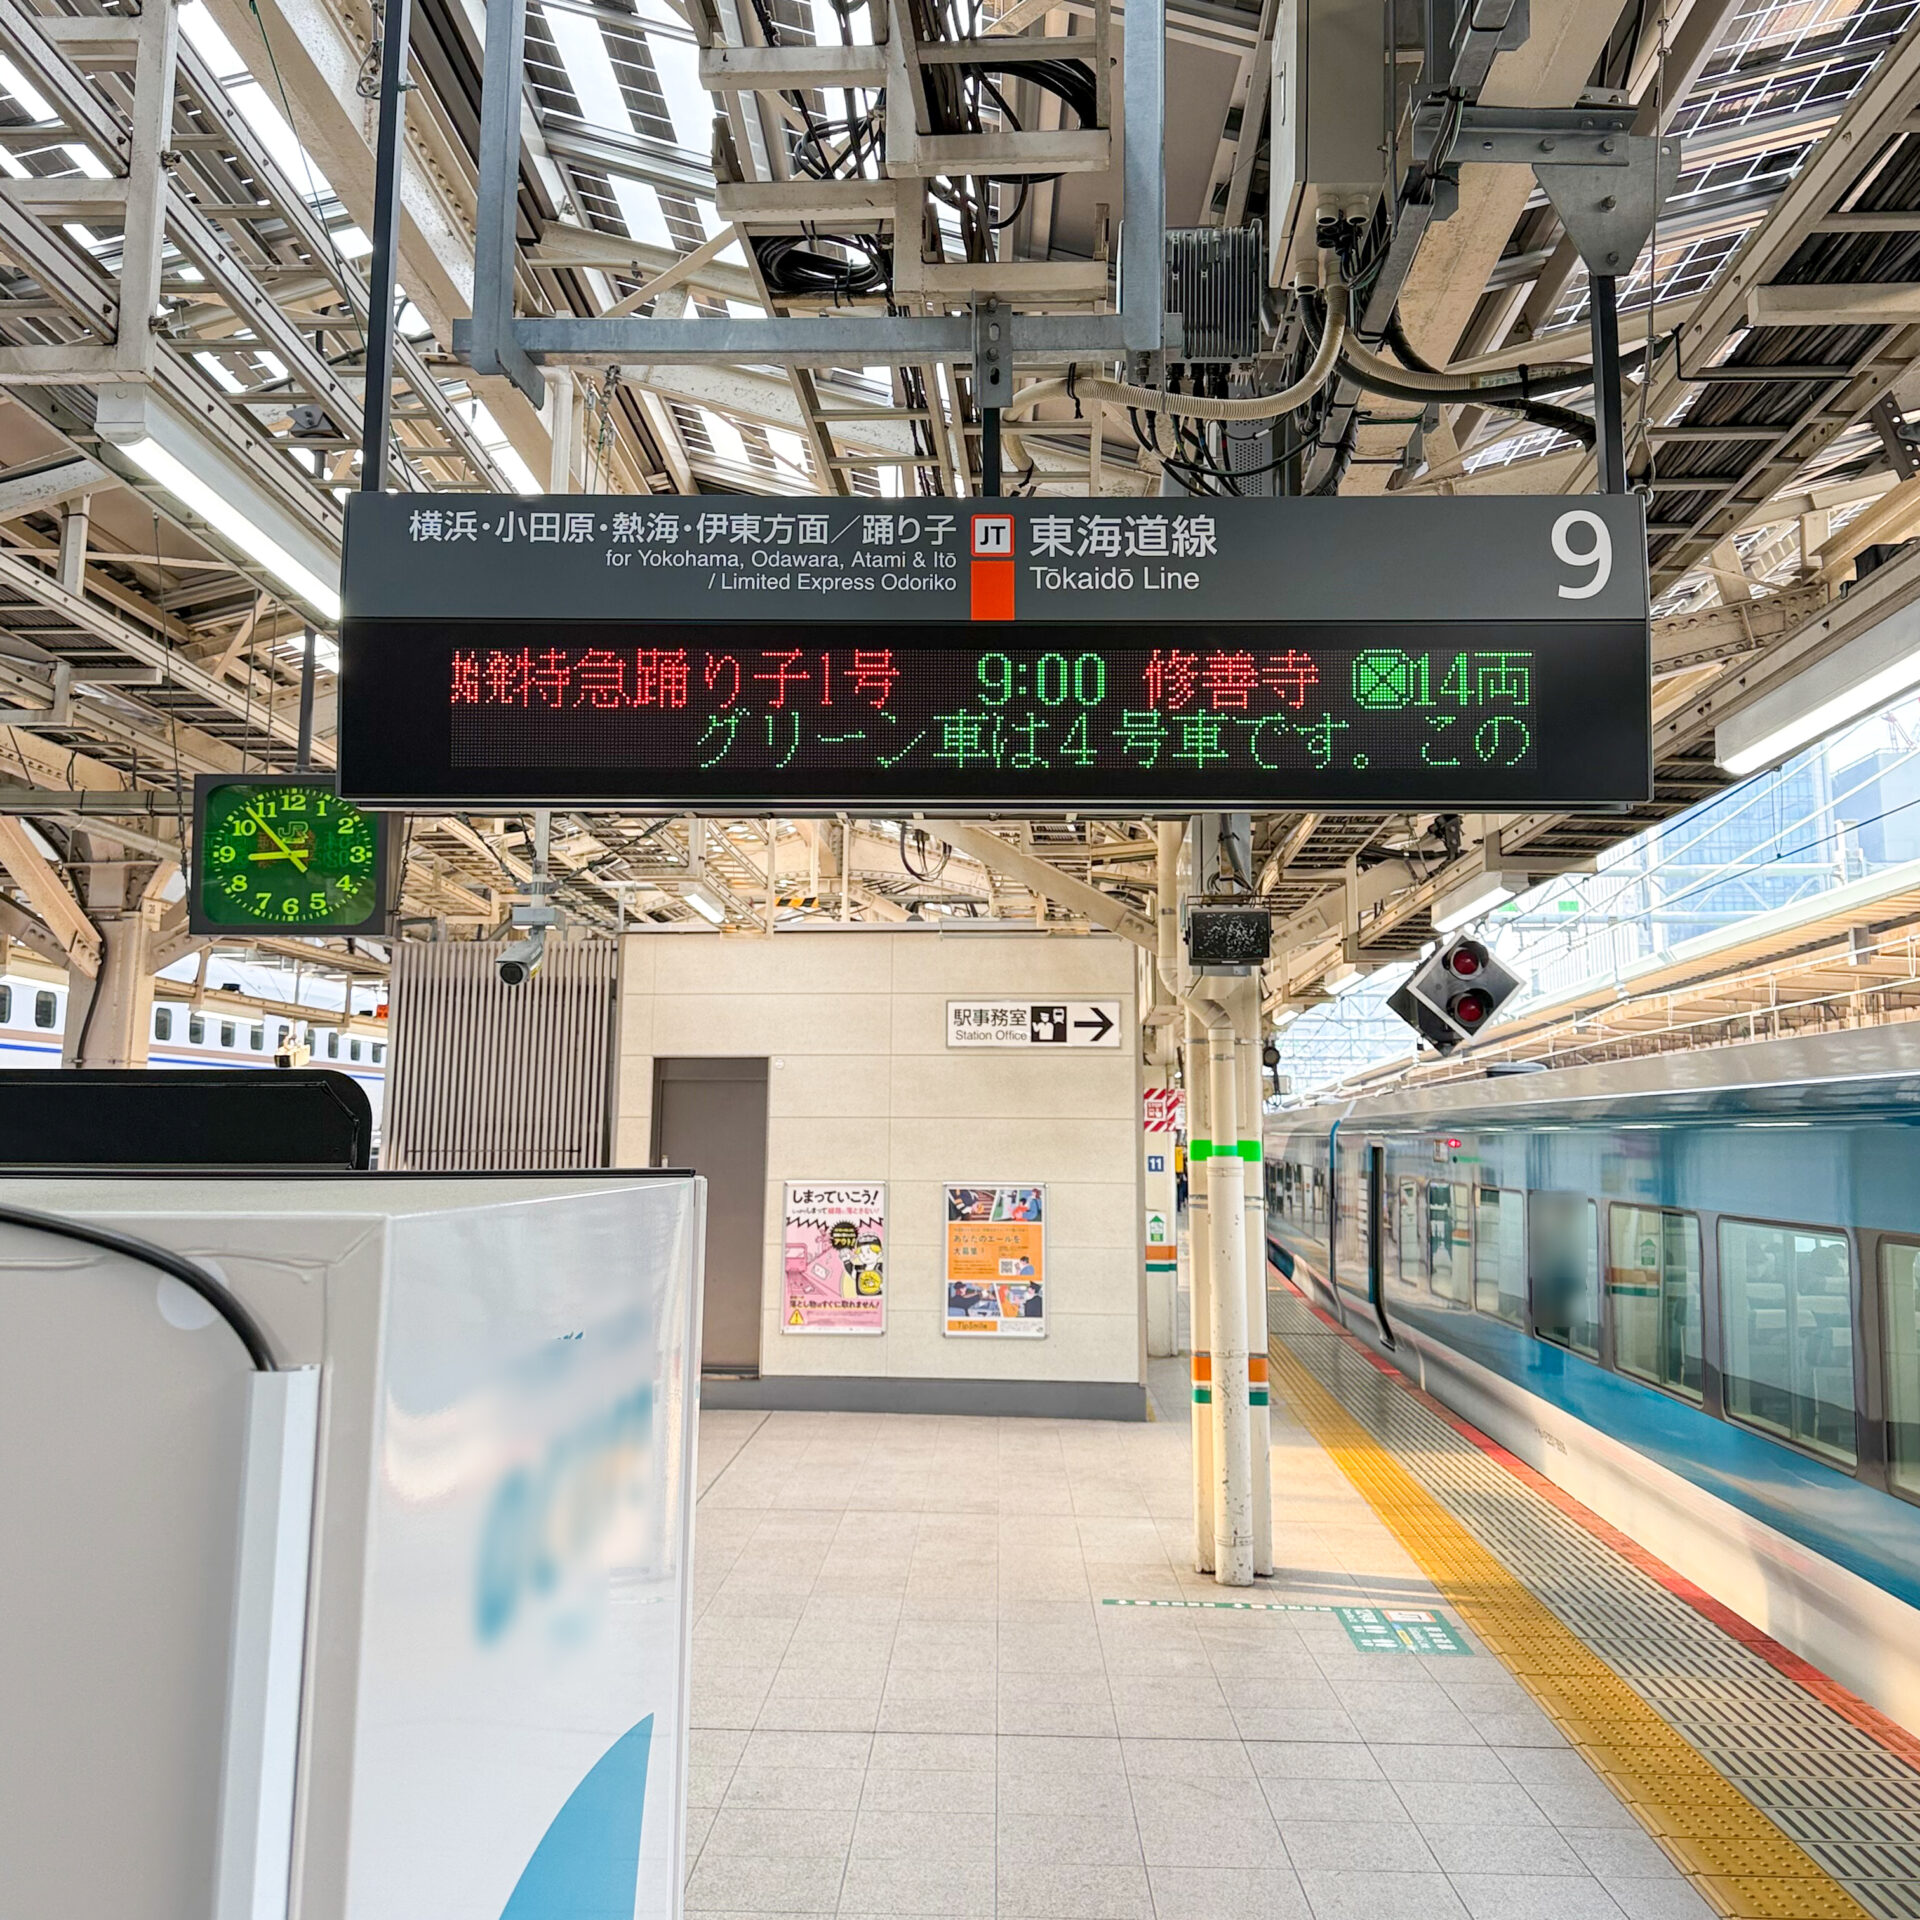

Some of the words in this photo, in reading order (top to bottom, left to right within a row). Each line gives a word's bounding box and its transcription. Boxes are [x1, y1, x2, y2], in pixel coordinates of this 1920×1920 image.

[979, 525, 1006, 547] JT
[1029, 514, 1218, 558] 東海道線
[605, 550, 632, 568] for
[638, 550, 745, 571] Yokohama,
[751, 550, 845, 571] Odawara,
[851, 550, 906, 568] Atami
[912, 550, 927, 568] &
[934, 550, 957, 568] Itō
[1551, 510, 1613, 599] 9
[721, 573, 790, 592] Limited
[797, 573, 875, 594] Express
[881, 573, 957, 592] Odoriko
[1029, 565, 1134, 590] Tōkaidō
[1144, 565, 1200, 590] Line
[977, 652, 1106, 706] 9:00
[1142, 648, 1320, 709] 修善寺
[1413, 651, 1533, 706] 14両
[256, 801, 278, 818] 11
[281, 794, 306, 811] 12
[316, 800, 328, 816] 1
[232, 819, 257, 836] 10
[337, 817, 354, 834] 2
[219, 846, 236, 863] 9
[350, 846, 366, 863] 3
[231, 874, 248, 892] 8
[336, 874, 354, 891] 4
[256, 892, 272, 909] 7
[282, 898, 299, 914] 6
[309, 892, 326, 909] 5
[953, 1008, 1028, 1027] 駅事務室
[955, 1030, 993, 1041] Station
[995, 1030, 1028, 1041] Office
[1149, 1157, 1163, 1170] 11
